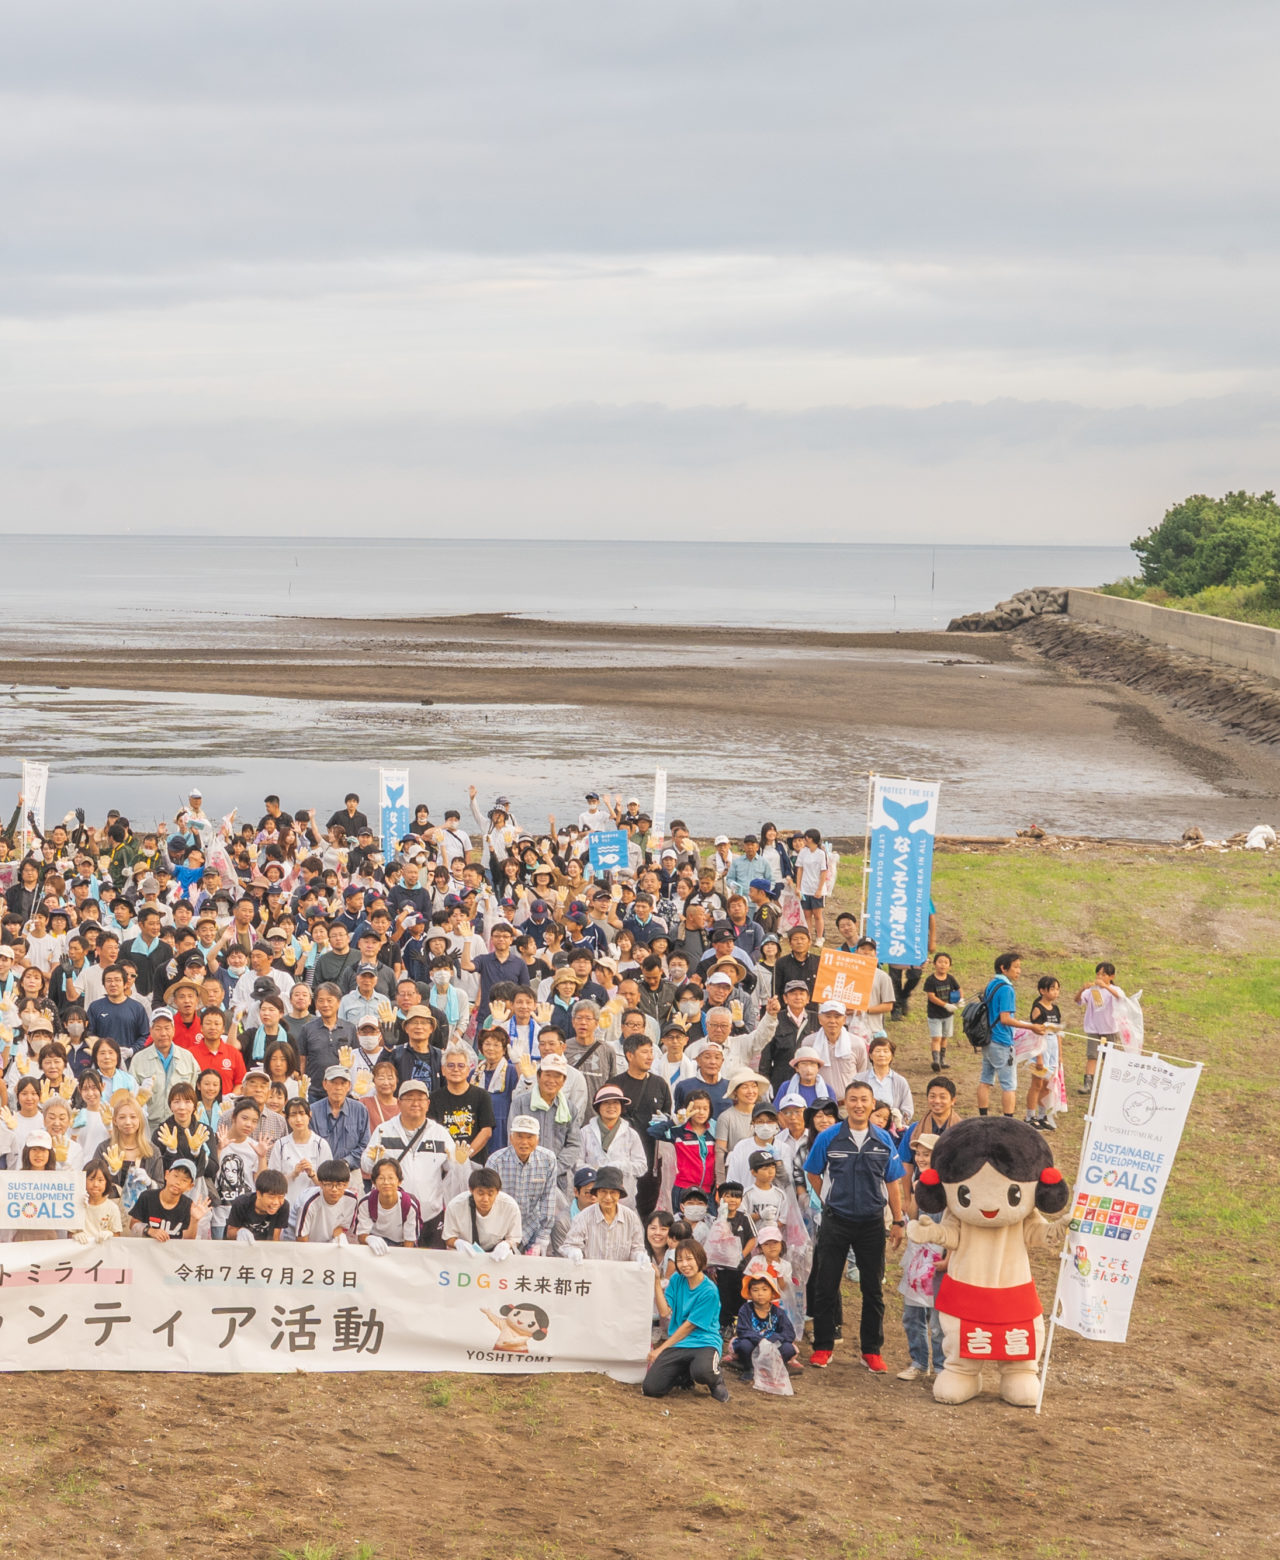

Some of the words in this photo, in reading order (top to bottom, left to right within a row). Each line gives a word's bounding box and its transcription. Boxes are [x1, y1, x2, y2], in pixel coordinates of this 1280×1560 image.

[590, 835, 599, 844] 14
[824, 953, 834, 965] 11
[1110, 1067, 1186, 1094] ヨシトミライ
[1093, 1141, 1165, 1164] SUSTAINABLE
[1090, 1152, 1161, 1174] DEVELOPMENT
[8, 1182, 75, 1191] SUSTAINABLE
[1085, 1165, 1158, 1195] GOALS
[8, 1192, 74, 1200] DEVELOPMENT
[7, 1201, 75, 1219] GOALS
[1098, 1255, 1129, 1271] こども
[174, 1263, 358, 1289] 令和7年9月28日
[966, 1327, 1030, 1356] 吉富
